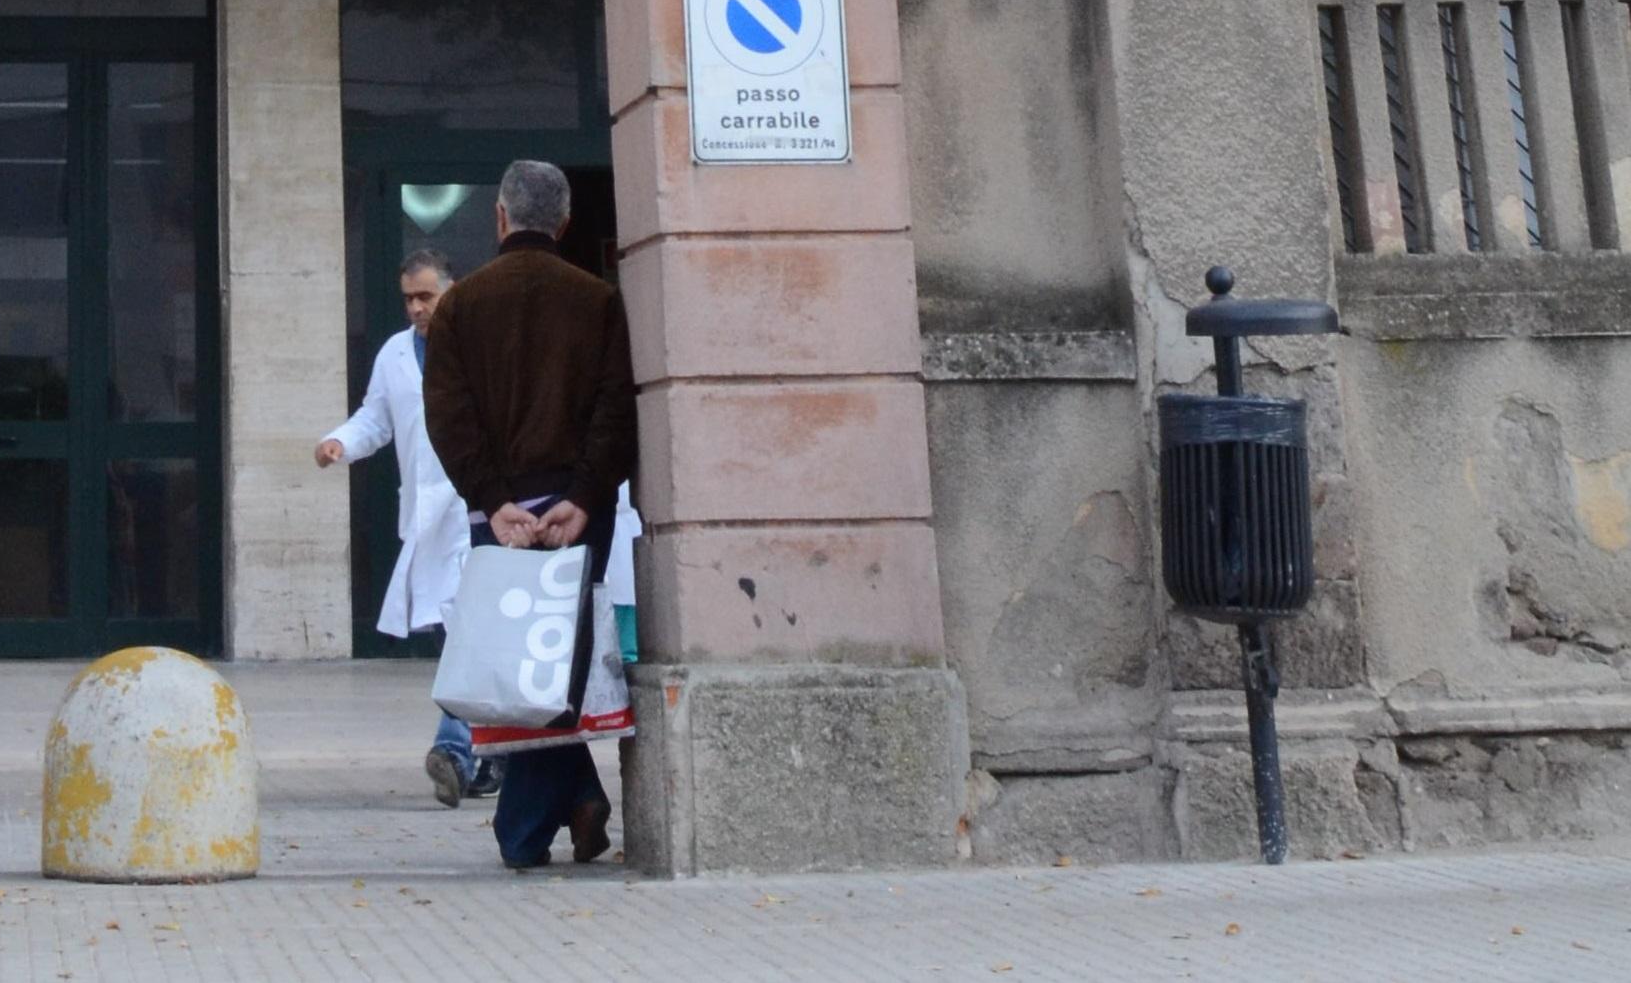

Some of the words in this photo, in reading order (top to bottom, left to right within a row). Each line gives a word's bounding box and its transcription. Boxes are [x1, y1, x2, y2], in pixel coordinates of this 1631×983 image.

[736, 88, 801, 105] passo
[720, 111, 820, 129] carrabile
[499, 545, 587, 705] coin
